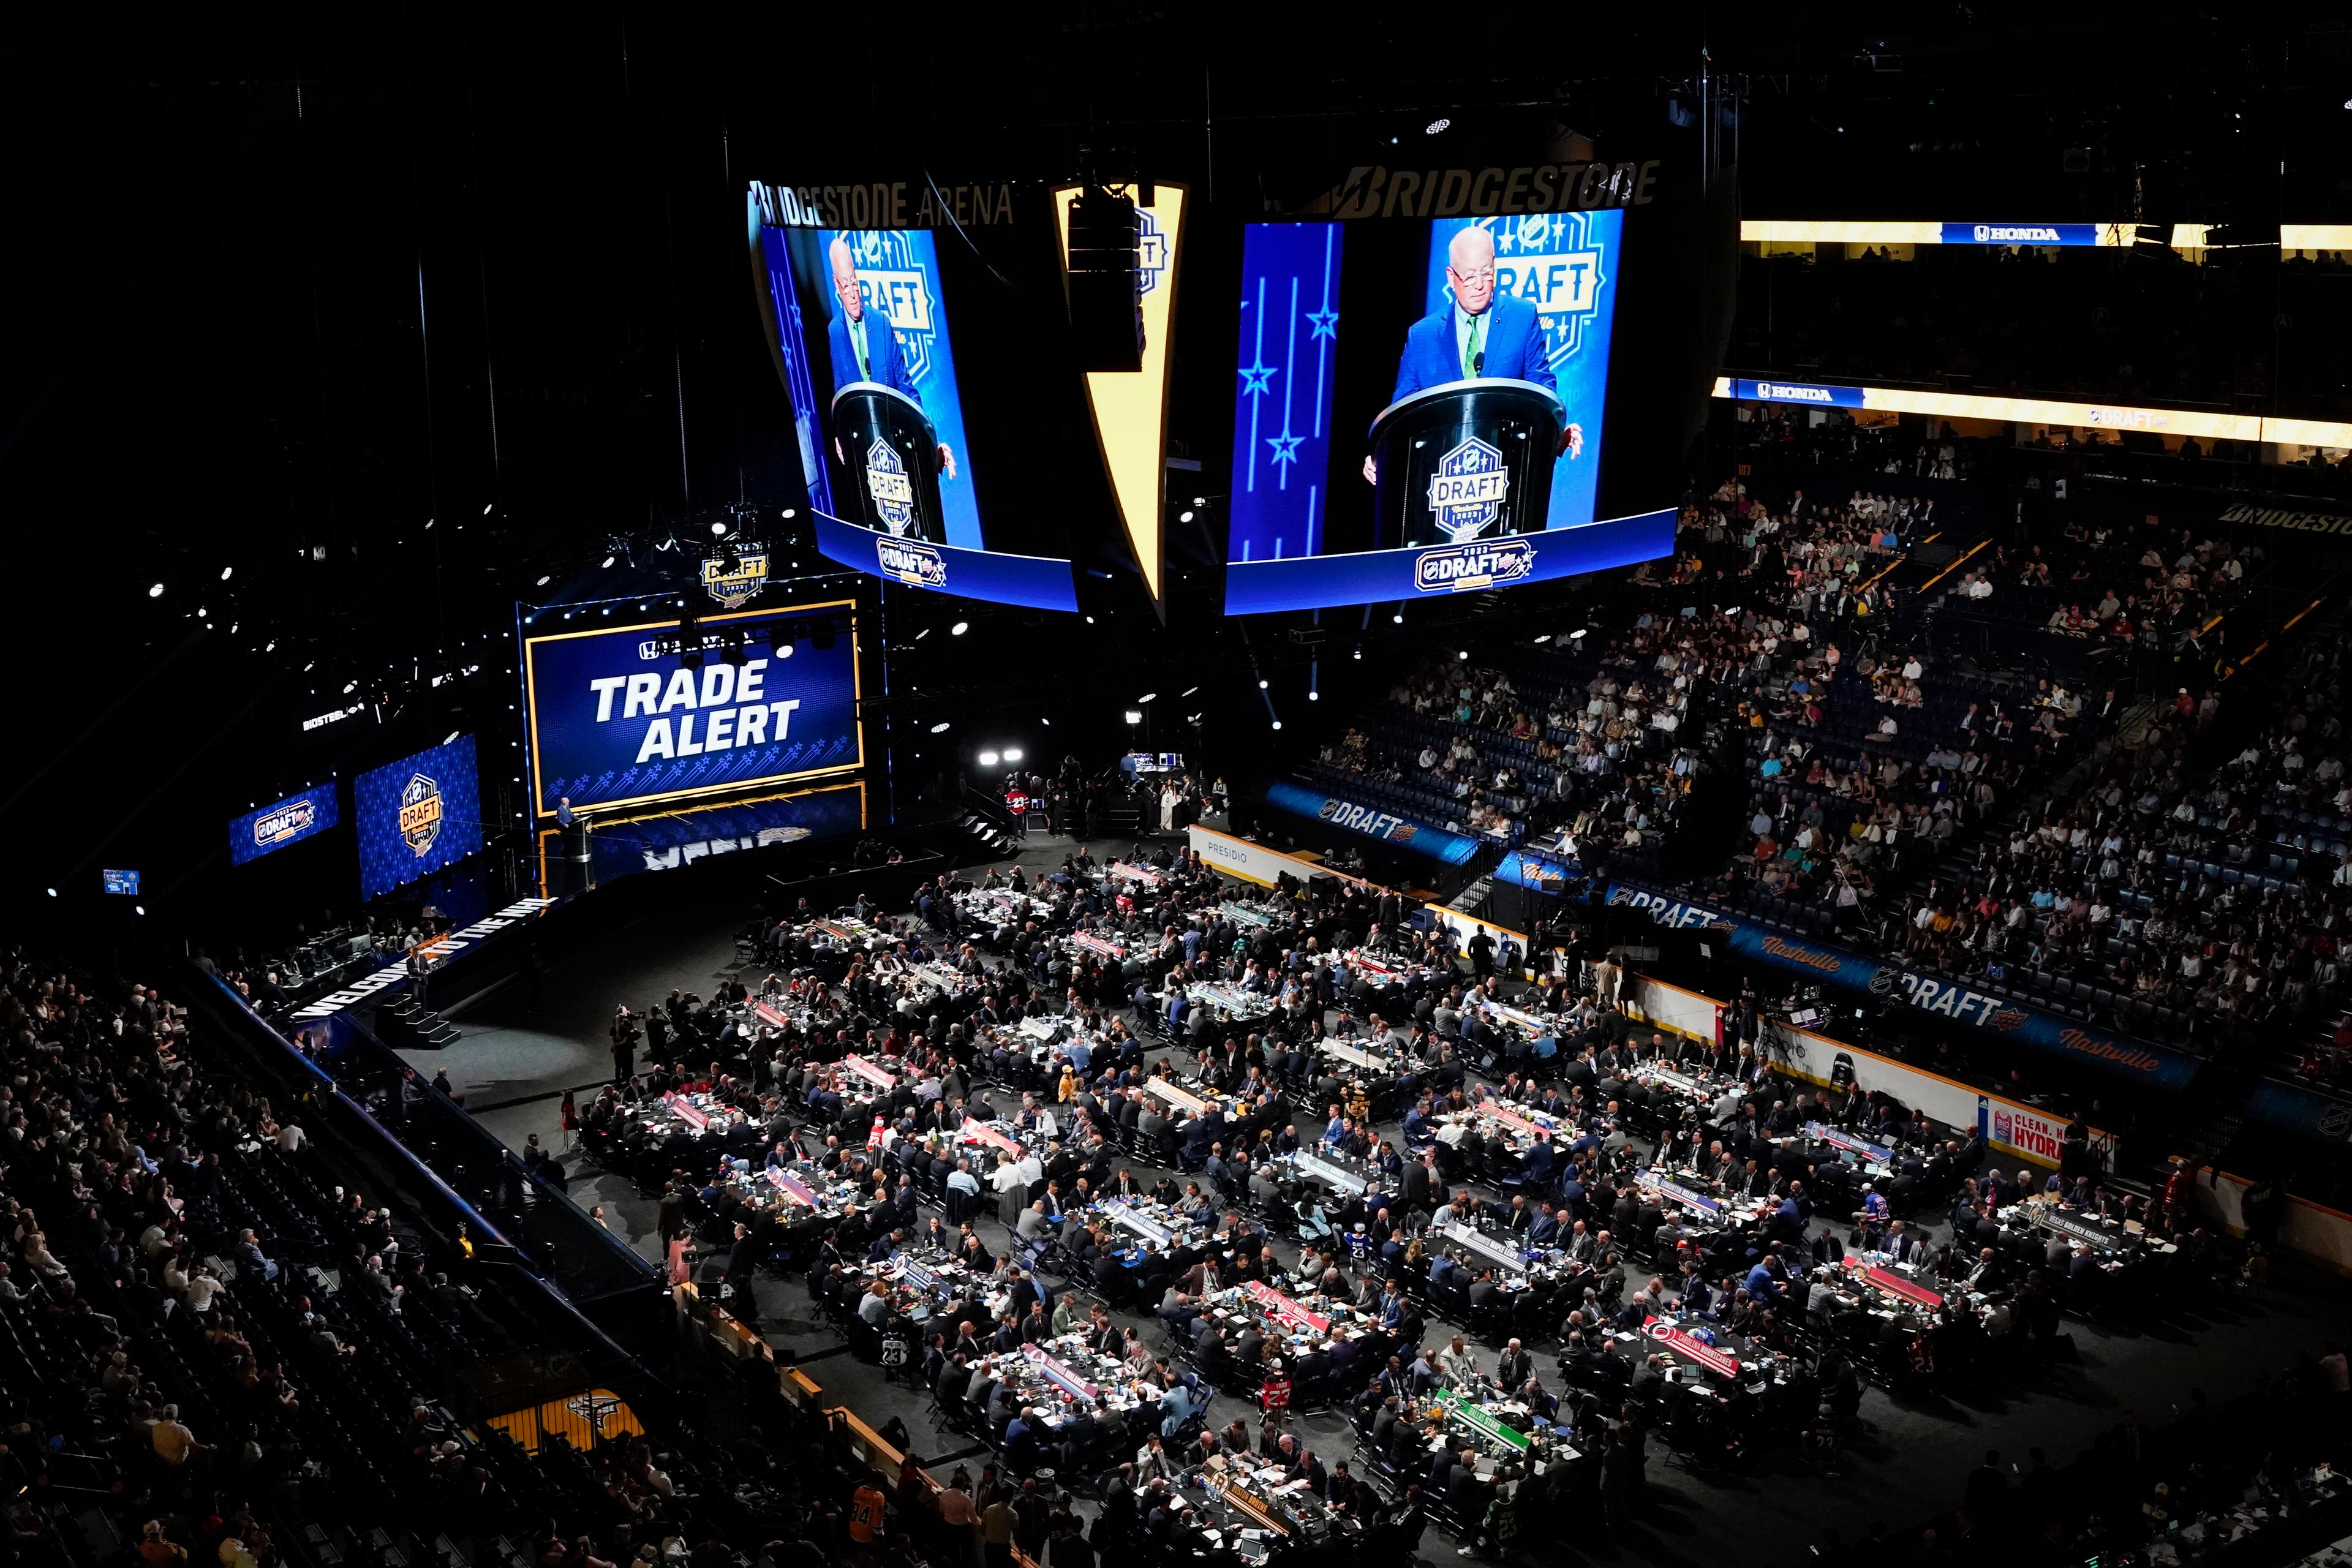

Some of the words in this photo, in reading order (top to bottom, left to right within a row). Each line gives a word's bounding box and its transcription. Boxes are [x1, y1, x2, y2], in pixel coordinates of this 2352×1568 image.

[1334, 160, 1660, 219] BRIDGESTONE
[749, 181, 907, 228] BRIDGESTONE
[919, 184, 1013, 226] ARENA
[1991, 227, 2060, 241] HONDA
[1494, 263, 1588, 304] RAFT
[858, 280, 918, 319] RAFT
[1771, 385, 1833, 402] HONDA
[2102, 408, 2154, 428] DRAFT
[872, 474, 905, 497] DRAFT
[1438, 476, 1500, 501] DRAFT
[1457, 511, 1477, 520] 2023
[889, 548, 923, 574] DRAFT
[1464, 546, 1488, 556] 2023
[1439, 552, 1501, 579] DRAFT
[590, 658, 768, 722] TRADE
[303, 710, 347, 731] BIOSTEEL
[636, 699, 800, 764] ALERT
[266, 811, 297, 835] DRAFT
[403, 801, 435, 827] DRAFT
[1333, 802, 1403, 840] DRAFT
[1208, 842, 1247, 863] PRESIDIO
[292, 957, 439, 1017] WELCOM
[420, 941, 469, 955] TO
[450, 918, 516, 938] THE
[494, 897, 559, 918] NHL
[1762, 935, 1841, 973] Nashville
[2059, 1028, 2160, 1072] Nashville
[1849, 1137, 1870, 1151] RANGERS
[2015, 1126, 2064, 1160] HYDRA
[1660, 1179, 1681, 1195] EDMONTON
[1681, 1187, 1698, 1201] OILERS
[2049, 1215, 2064, 1226] VEGAS
[2063, 1220, 2082, 1234] GOLDEN
[2083, 1229, 2109, 1244] KNIGHTS
[1352, 1247, 1365, 1259] 23
[1472, 1232, 1490, 1245] TORONTO
[1490, 1238, 1505, 1254] MAPLE
[1504, 1246, 1519, 1260] LEAFS
[909, 1261, 924, 1277] WINNIPEG
[923, 1270, 932, 1282] JETS
[1294, 1303, 1310, 1319] DEVILS
[884, 1348, 901, 1365] 23
[1678, 1333, 1699, 1349] CAROLINA
[1698, 1342, 1732, 1367] HURRICANES
[1047, 1359, 1066, 1376] COLORADO
[1065, 1368, 1087, 1390] AVALANCHE
[1467, 1408, 1483, 1424] DALLAS
[1483, 1415, 1500, 1432] STARS
[1231, 1483, 1250, 1501] BOSTON
[1248, 1493, 1268, 1513] BRUINS
